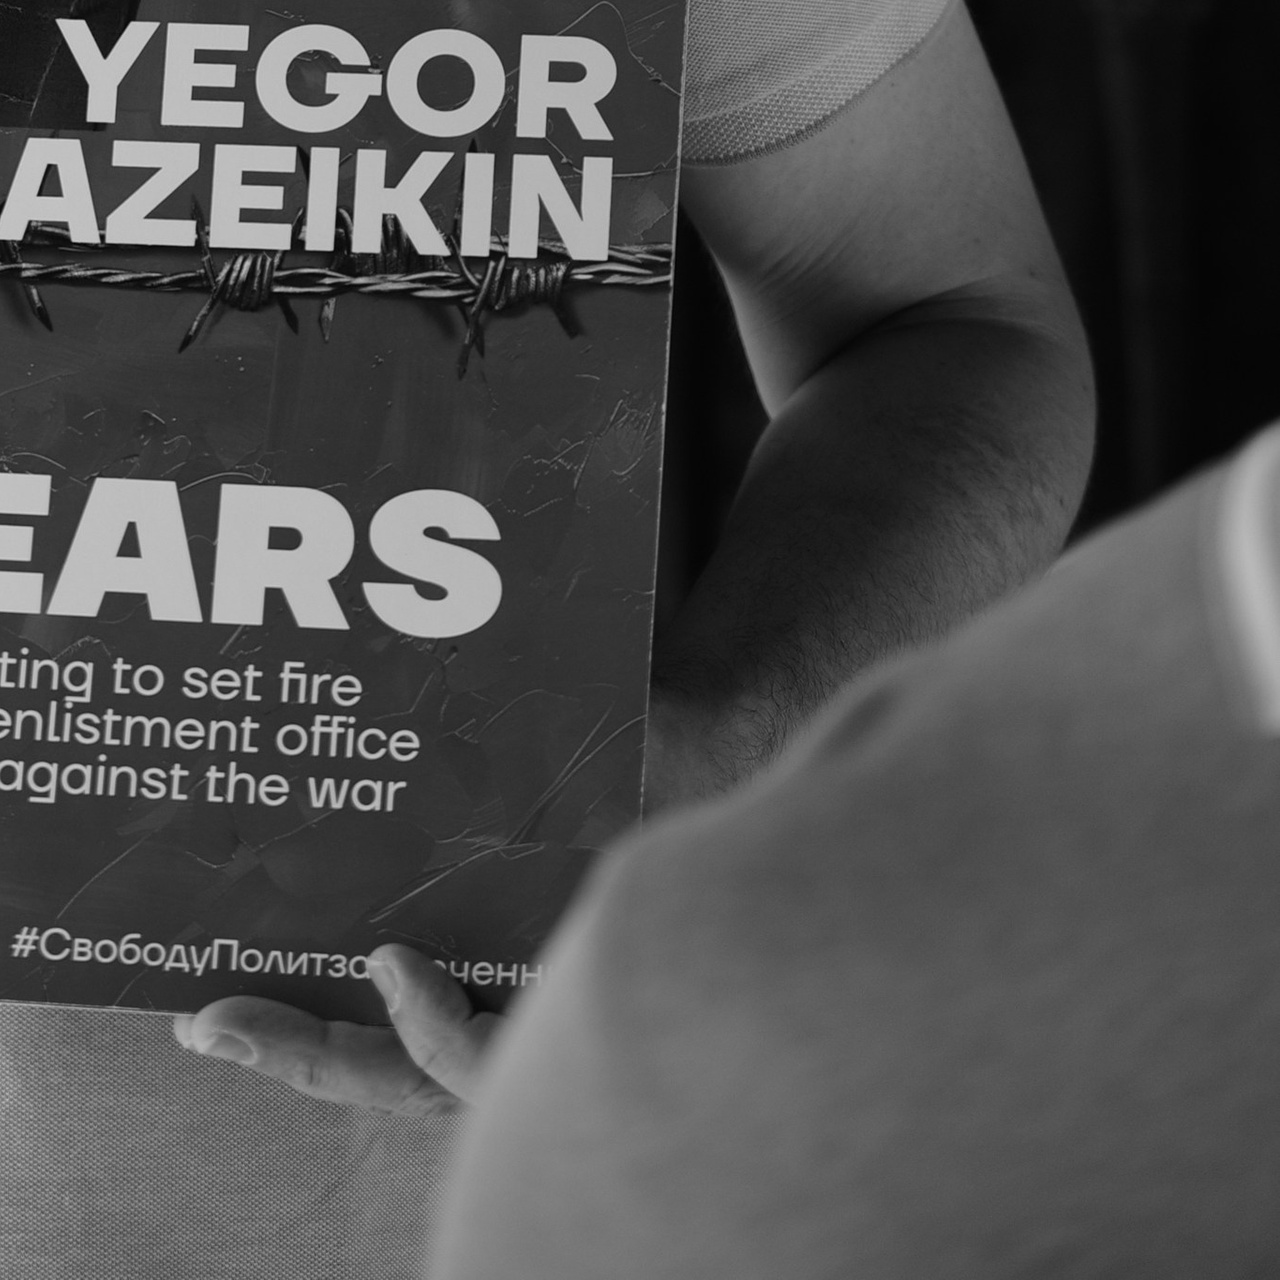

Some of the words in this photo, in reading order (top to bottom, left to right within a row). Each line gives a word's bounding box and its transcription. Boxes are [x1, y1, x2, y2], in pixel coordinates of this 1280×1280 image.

[55, 18, 617, 141] YEGOR
[112, 657, 165, 696] to
[182, 664, 263, 702] set
[279, 661, 363, 707] fire
[276, 714, 420, 762] office
[205, 761, 290, 807] the
[308, 777, 407, 812] war
